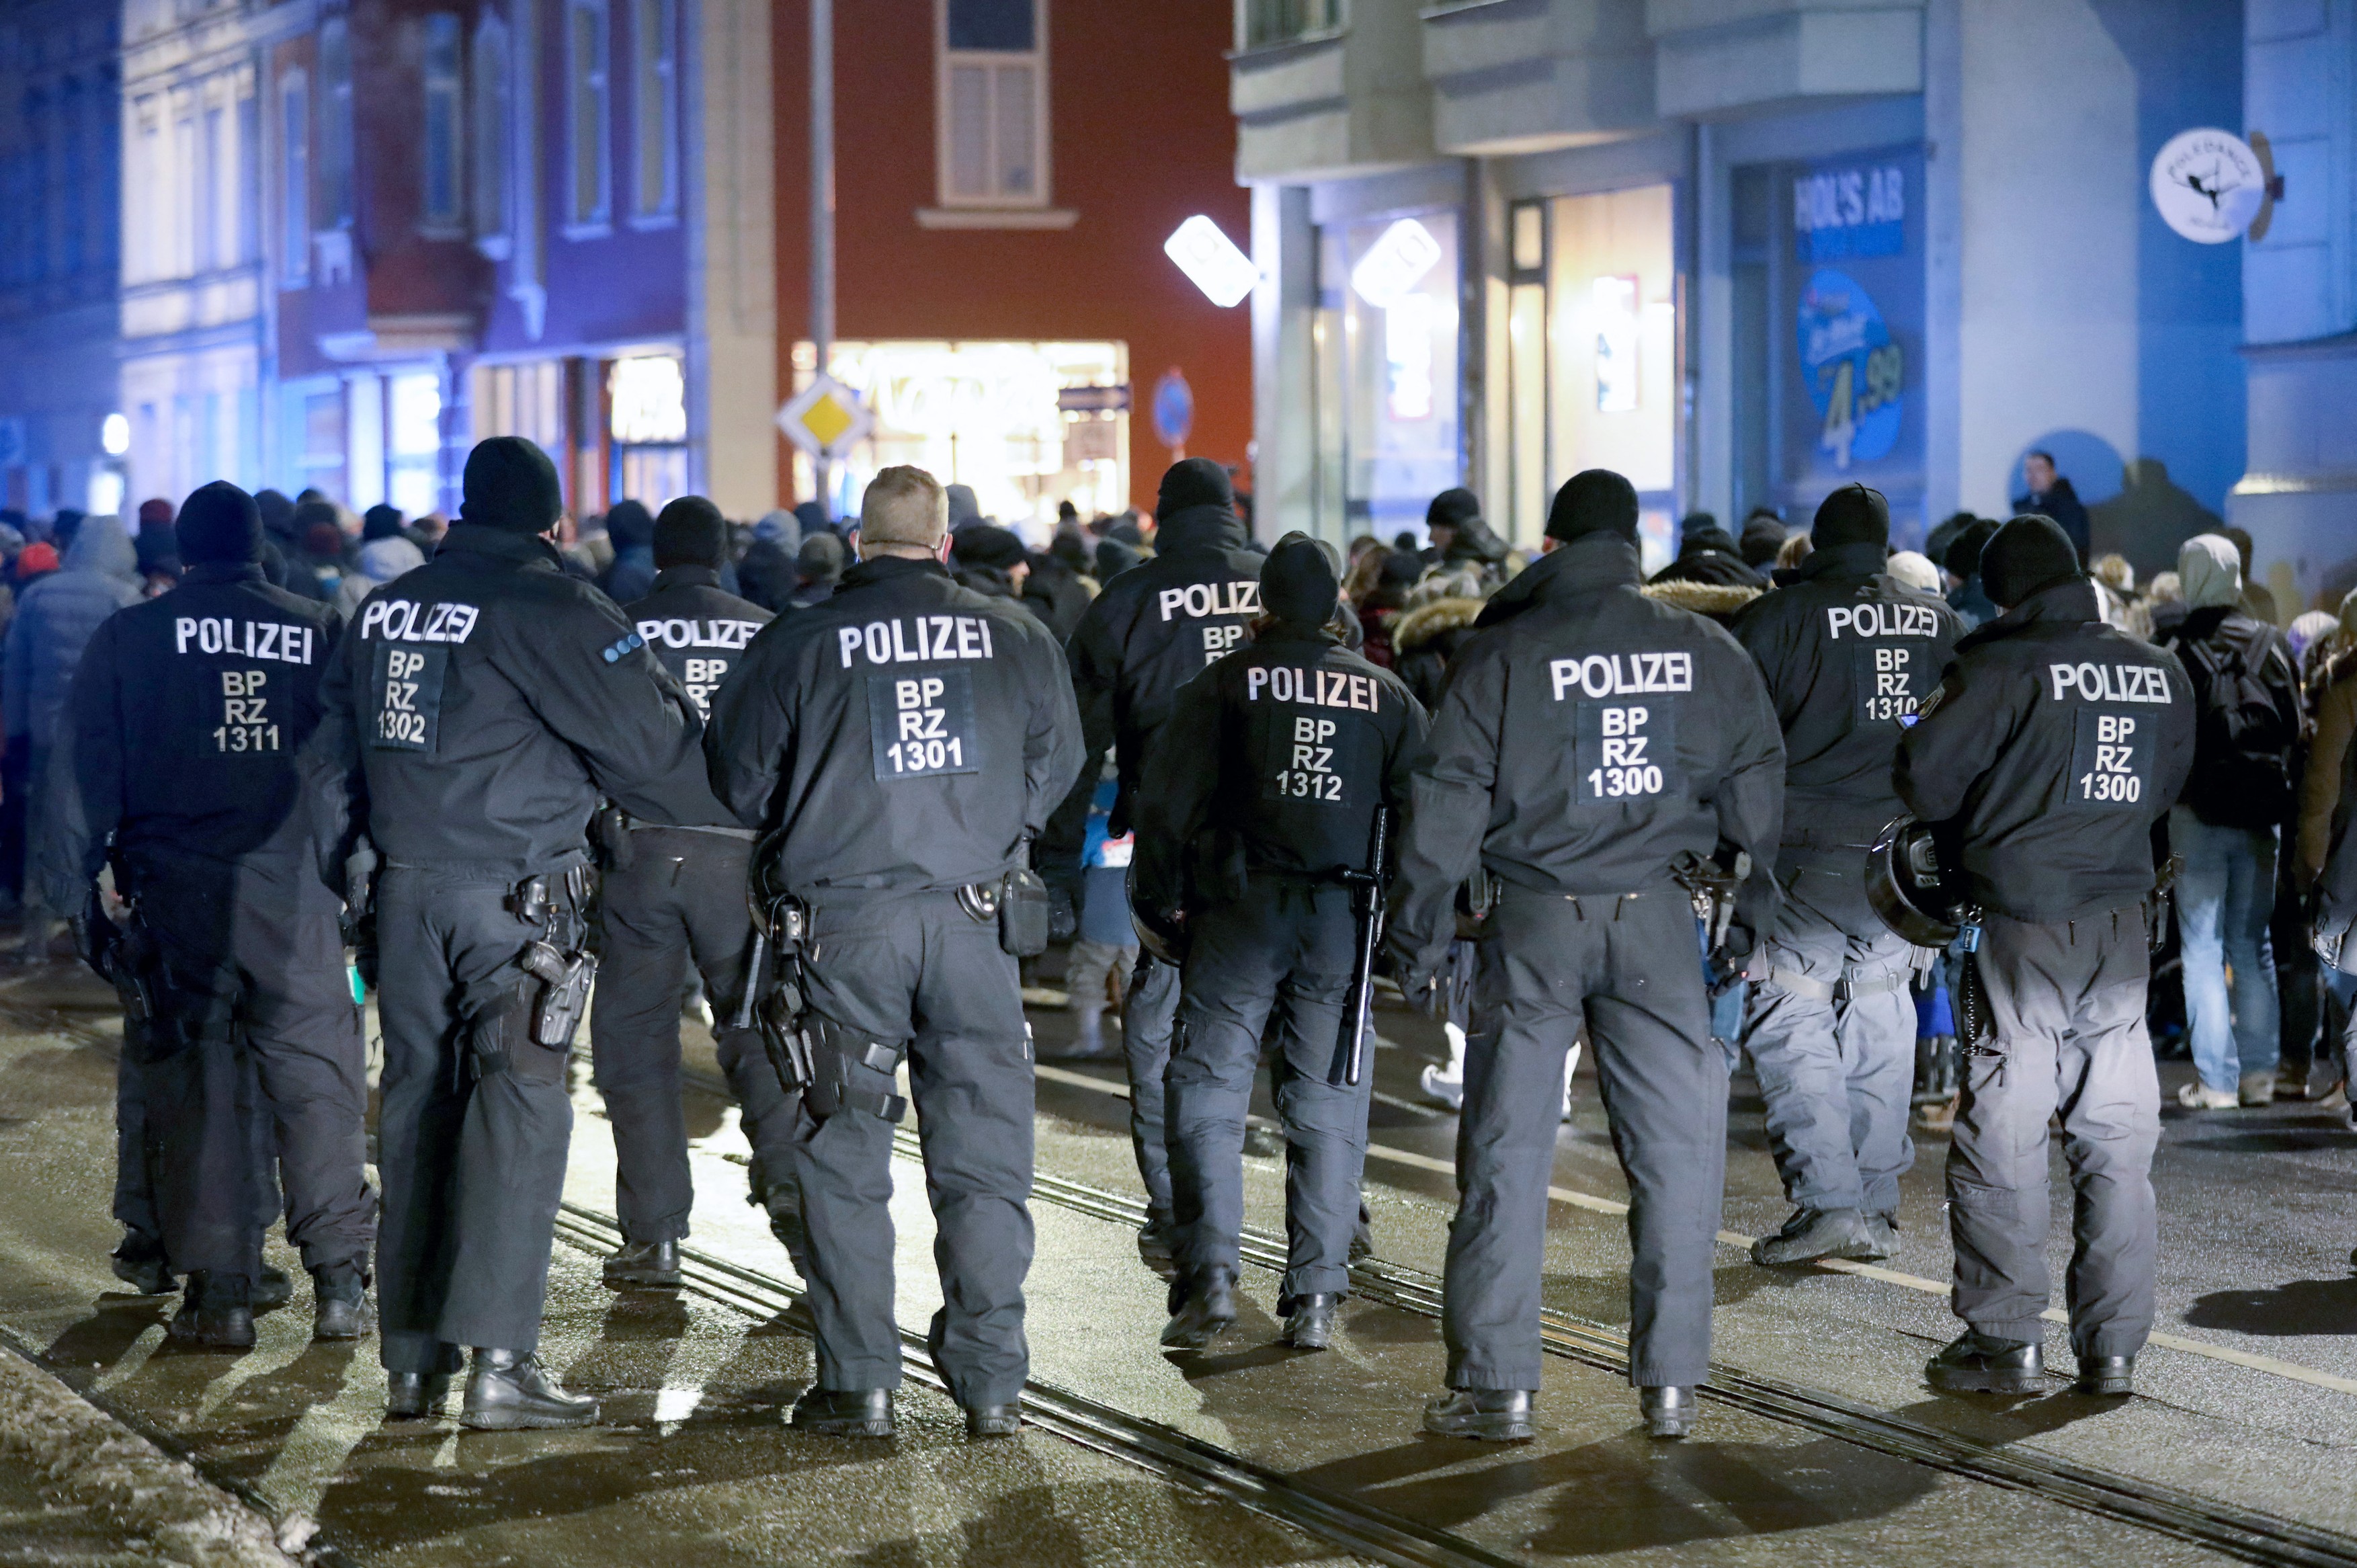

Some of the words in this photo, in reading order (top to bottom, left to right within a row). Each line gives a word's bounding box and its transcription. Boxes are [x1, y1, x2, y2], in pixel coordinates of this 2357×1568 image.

[1159, 581, 1260, 622] POLIZ
[362, 601, 479, 644] POLIZEI
[636, 619, 764, 651] POLIZE
[1827, 604, 1938, 639] POLIZEI
[176, 618, 313, 665] POLIZEI
[839, 616, 993, 668] POLIZEI
[1203, 625, 1243, 650] BP
[388, 650, 425, 679] BP
[686, 659, 728, 682] BP
[1876, 649, 1909, 671] BP
[222, 671, 267, 696] BP
[1248, 666, 1378, 714] POLIZEI
[1550, 652, 1693, 701] POLIZEI
[1877, 673, 1909, 696] RZ
[2050, 662, 2172, 704] POLIZEI
[386, 682, 419, 711] RZ
[896, 678, 945, 709] BP
[1866, 697, 1918, 720] 1310
[225, 698, 268, 725] RZ
[899, 710, 948, 740] RZ
[1602, 707, 1649, 737] BP
[213, 725, 279, 752] 1311
[378, 712, 425, 744] 1302
[1294, 717, 1336, 745] BP
[2098, 716, 2135, 743] BP
[887, 737, 962, 773] 1301
[1293, 745, 1333, 772] RZ
[1602, 737, 1648, 767] RZ
[2096, 745, 2133, 774] RZ
[1276, 770, 1342, 801] 1312
[1587, 765, 1663, 798] 1300
[2080, 774, 2141, 803] 1300
